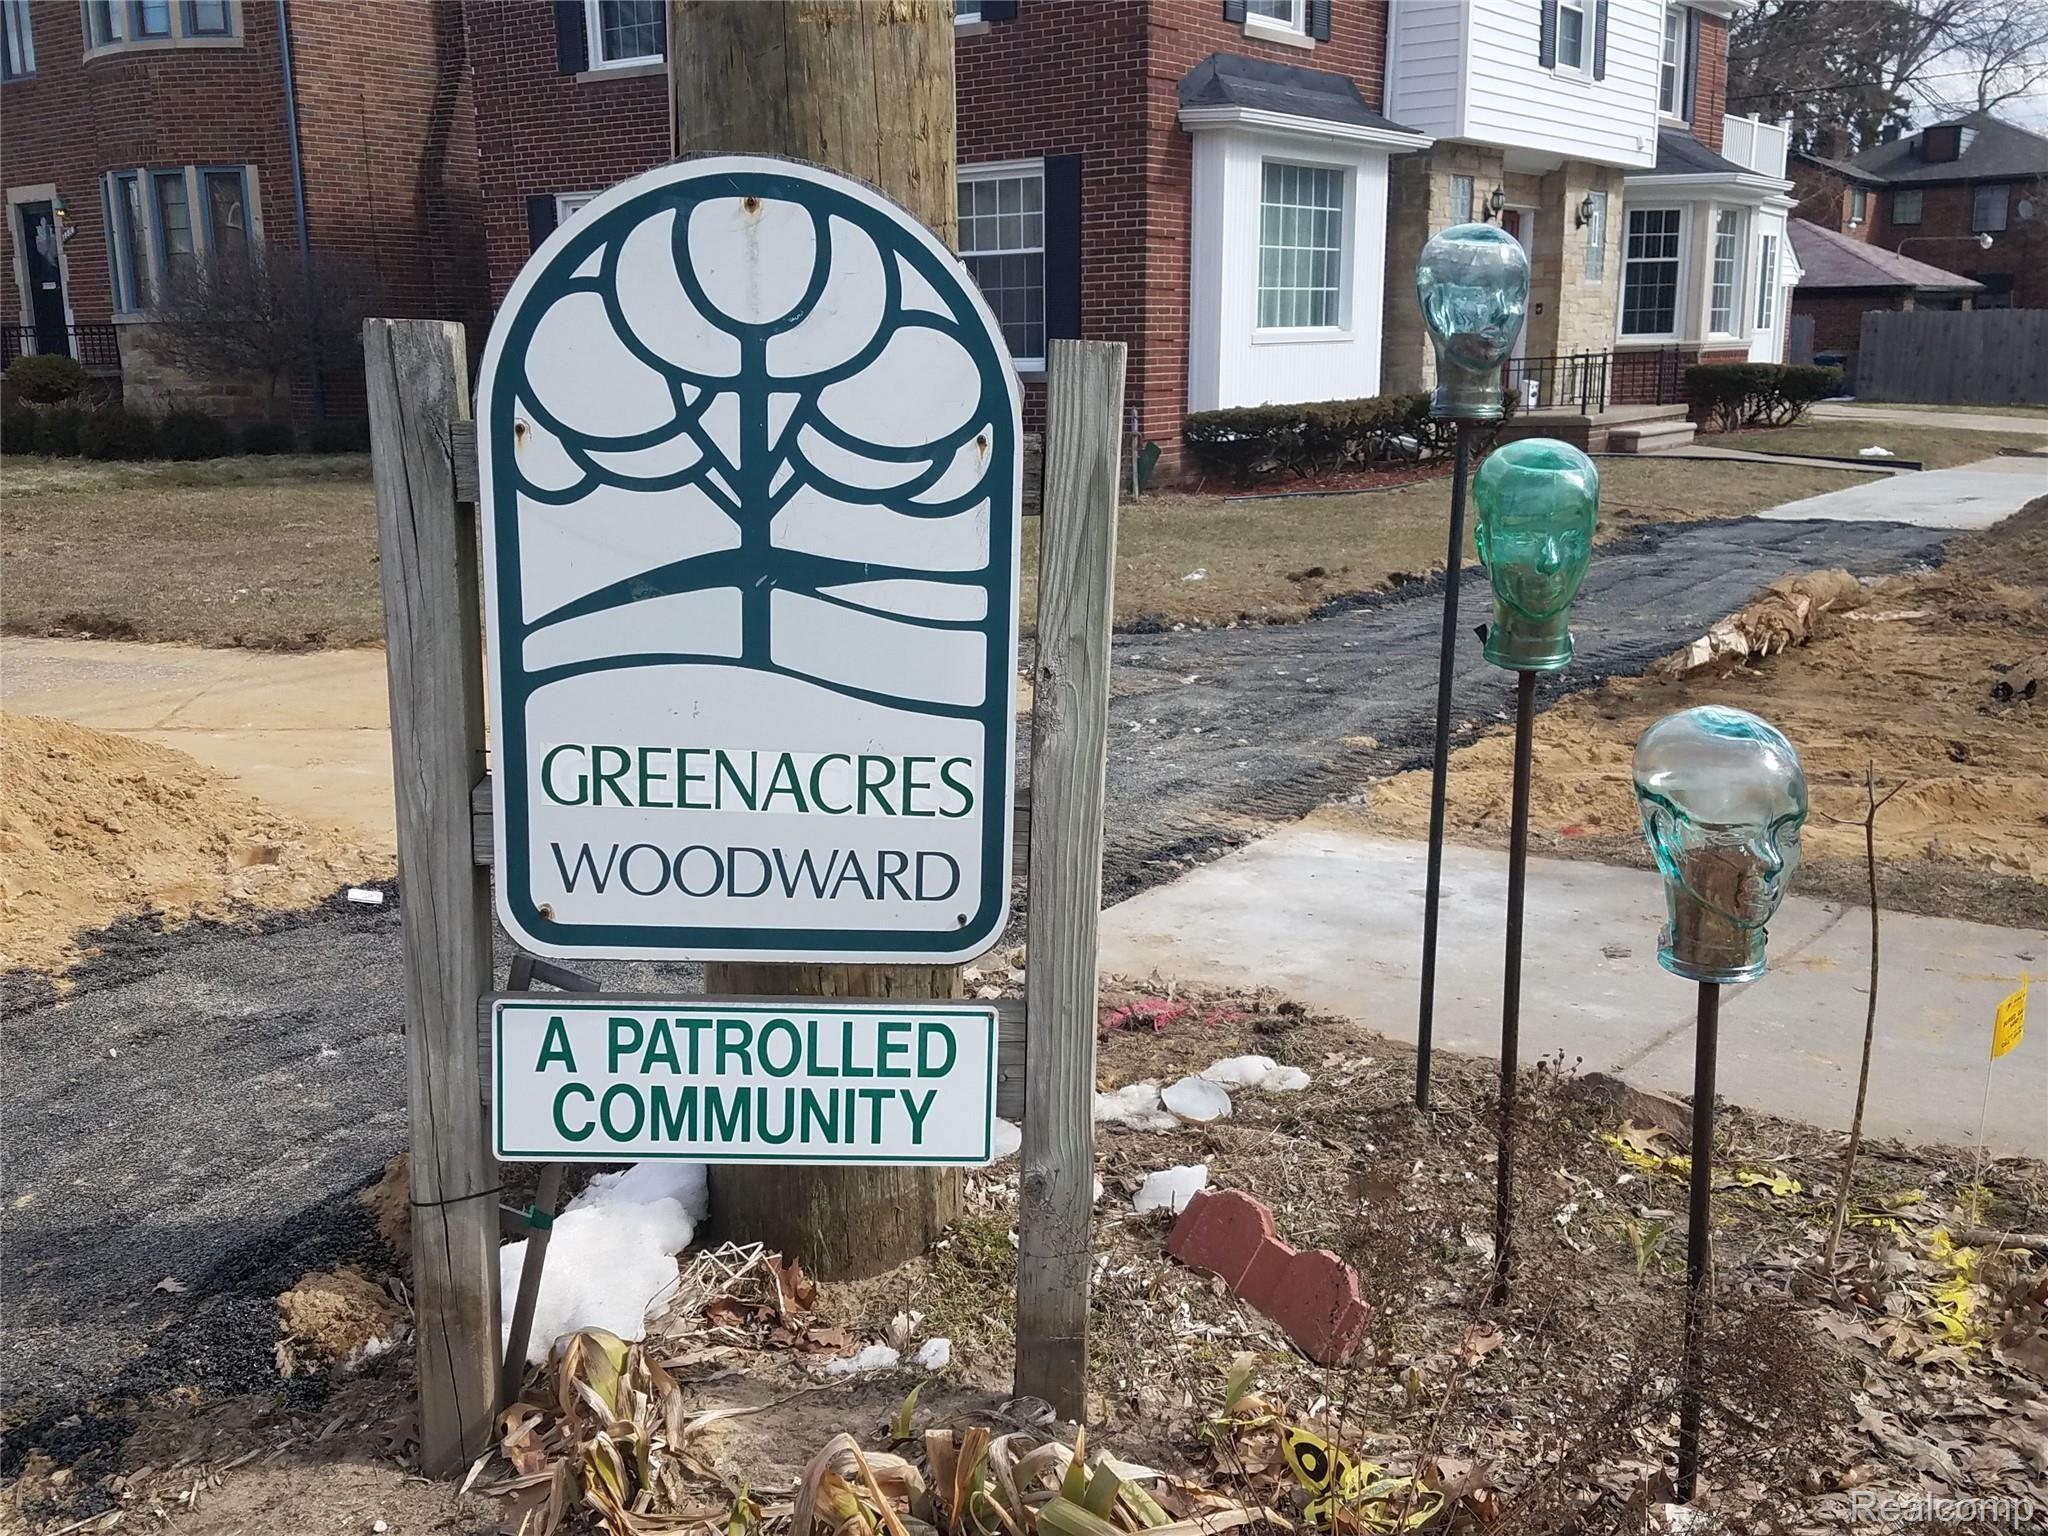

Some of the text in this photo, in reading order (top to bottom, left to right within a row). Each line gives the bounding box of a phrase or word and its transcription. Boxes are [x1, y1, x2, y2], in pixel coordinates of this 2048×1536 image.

[541, 744, 975, 818] GREENACRES
[551, 842, 961, 901] WOODWARD
[535, 1016, 956, 1078] A PATROLLED
[552, 1083, 938, 1146] COMMUNITY
